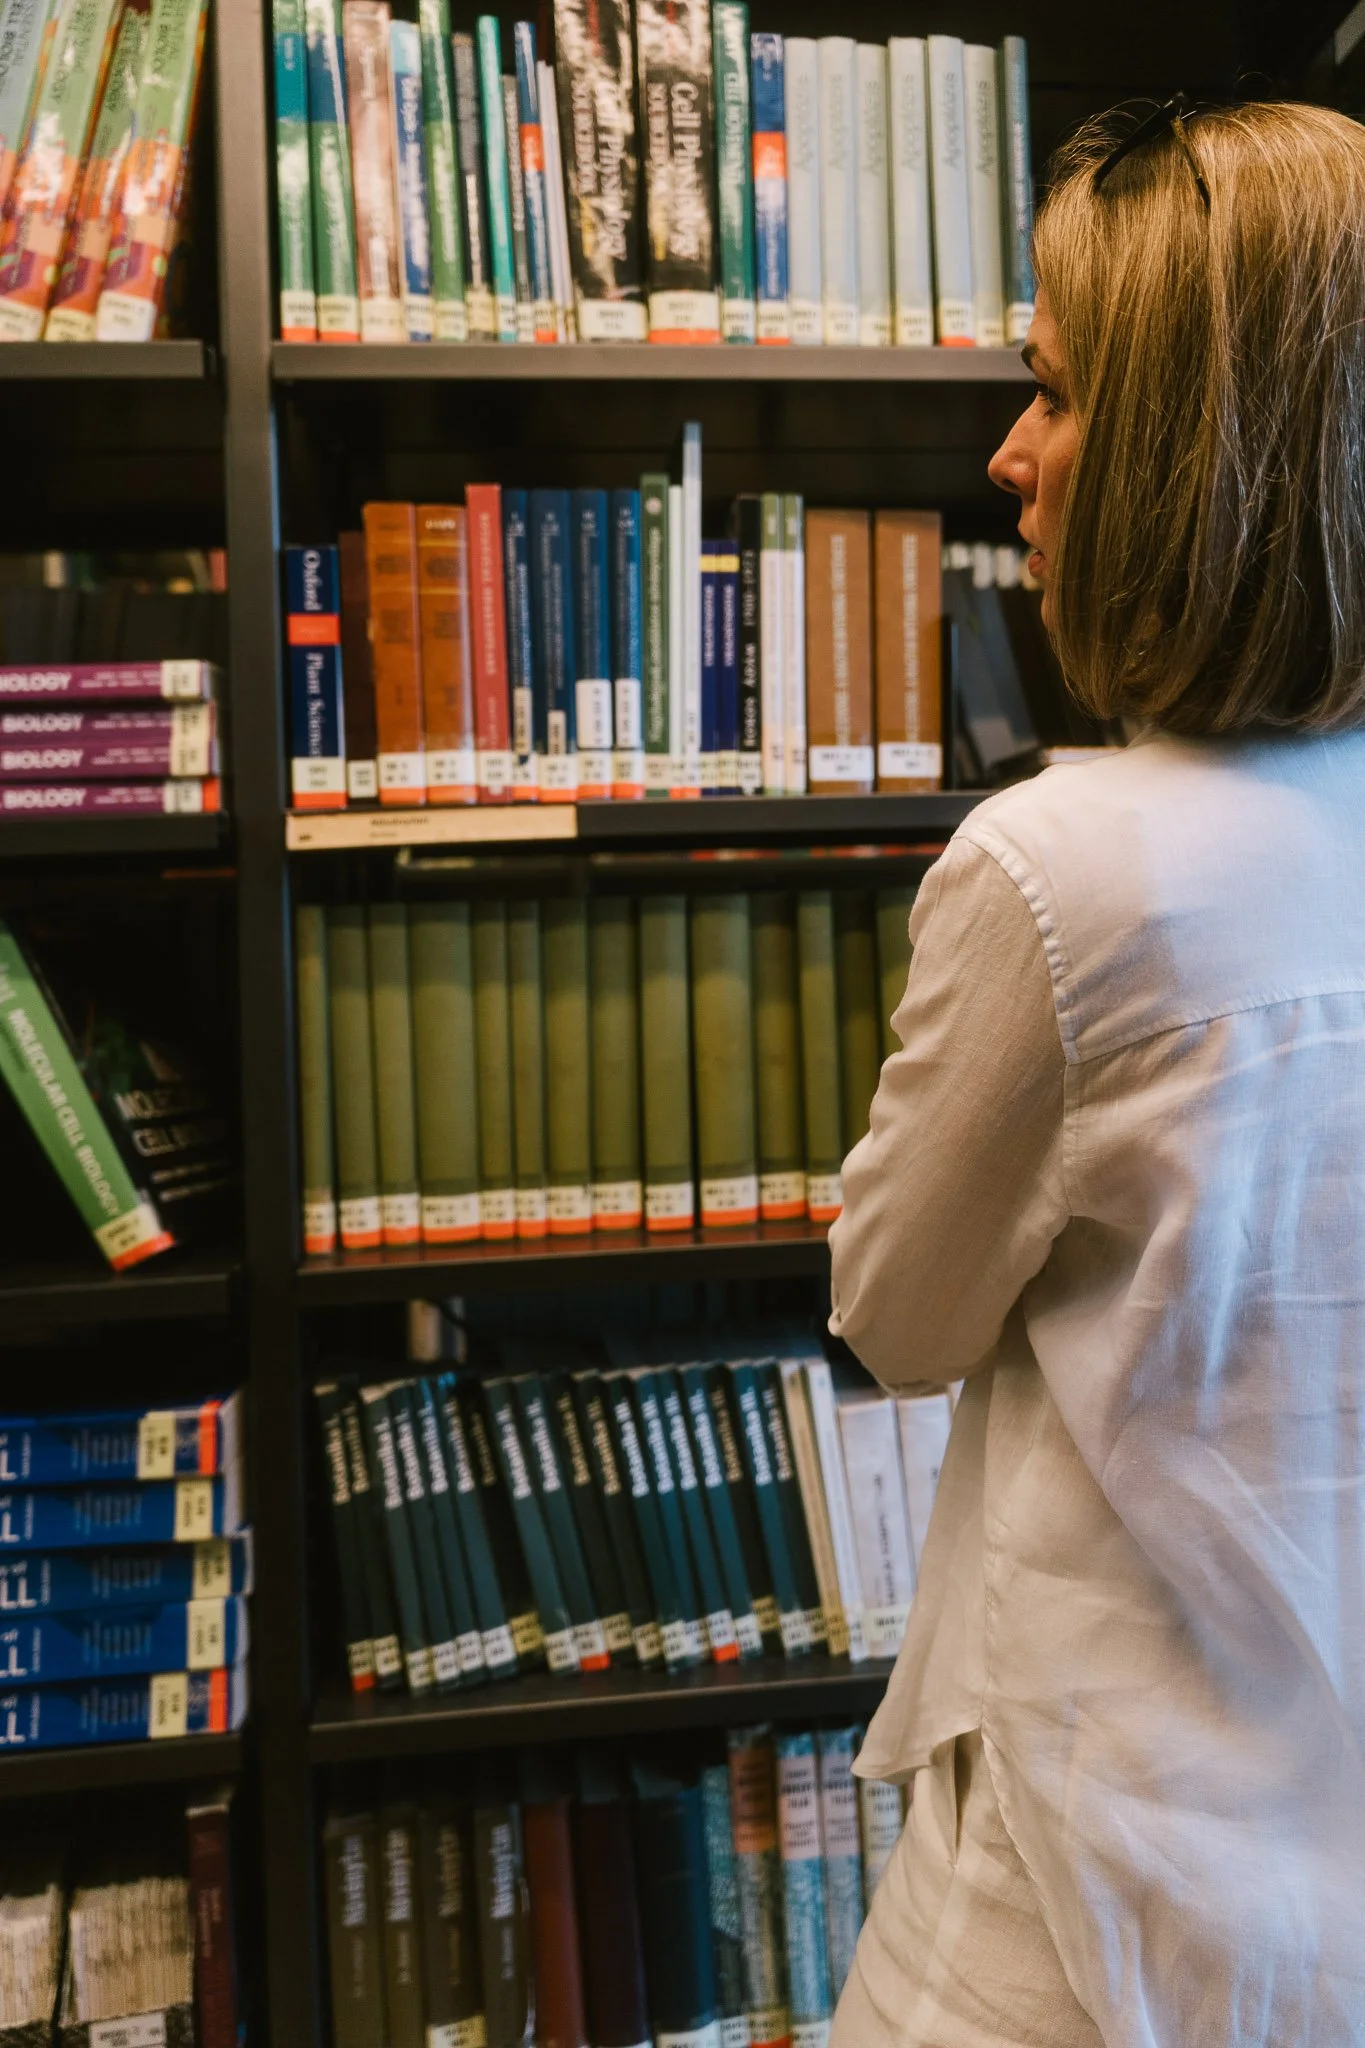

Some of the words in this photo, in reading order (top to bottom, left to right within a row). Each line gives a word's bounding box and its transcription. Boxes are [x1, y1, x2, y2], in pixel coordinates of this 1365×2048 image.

[671, 82, 702, 128] Cell
[670, 134, 704, 260] Physiology
[304, 550, 323, 611] Oxford
[0, 672, 71, 691] IOLOGY
[305, 652, 325, 695] Plant
[2, 713, 84, 733] BIOLOGY
[2, 749, 84, 769] BIOLOGY
[3, 788, 86, 809] BIOLOGY
[7, 1005, 69, 1107] MOLECULAR
[56, 1103, 85, 1147] CELL
[76, 1144, 122, 1217] BIOLOGY
[376, 1433, 403, 1509] Botanika
[395, 1423, 424, 1499] Botanika
[421, 1417, 448, 1494] Botanika
[447, 1418, 474, 1493] Botanika
[500, 1423, 531, 1499] Botanika
[529, 1417, 561, 1492] Botanika
[559, 1412, 591, 1486] Botanika
[590, 1421, 621, 1495] Botanika
[619, 1422, 649, 1497] Botanika
[645, 1419, 674, 1494] Botanika
[668, 1416, 697, 1490] Botanika
[693, 1413, 722, 1488] Botanika
[743, 1411, 773, 1486] Botanika
[766, 1408, 792, 1481] Botanika
